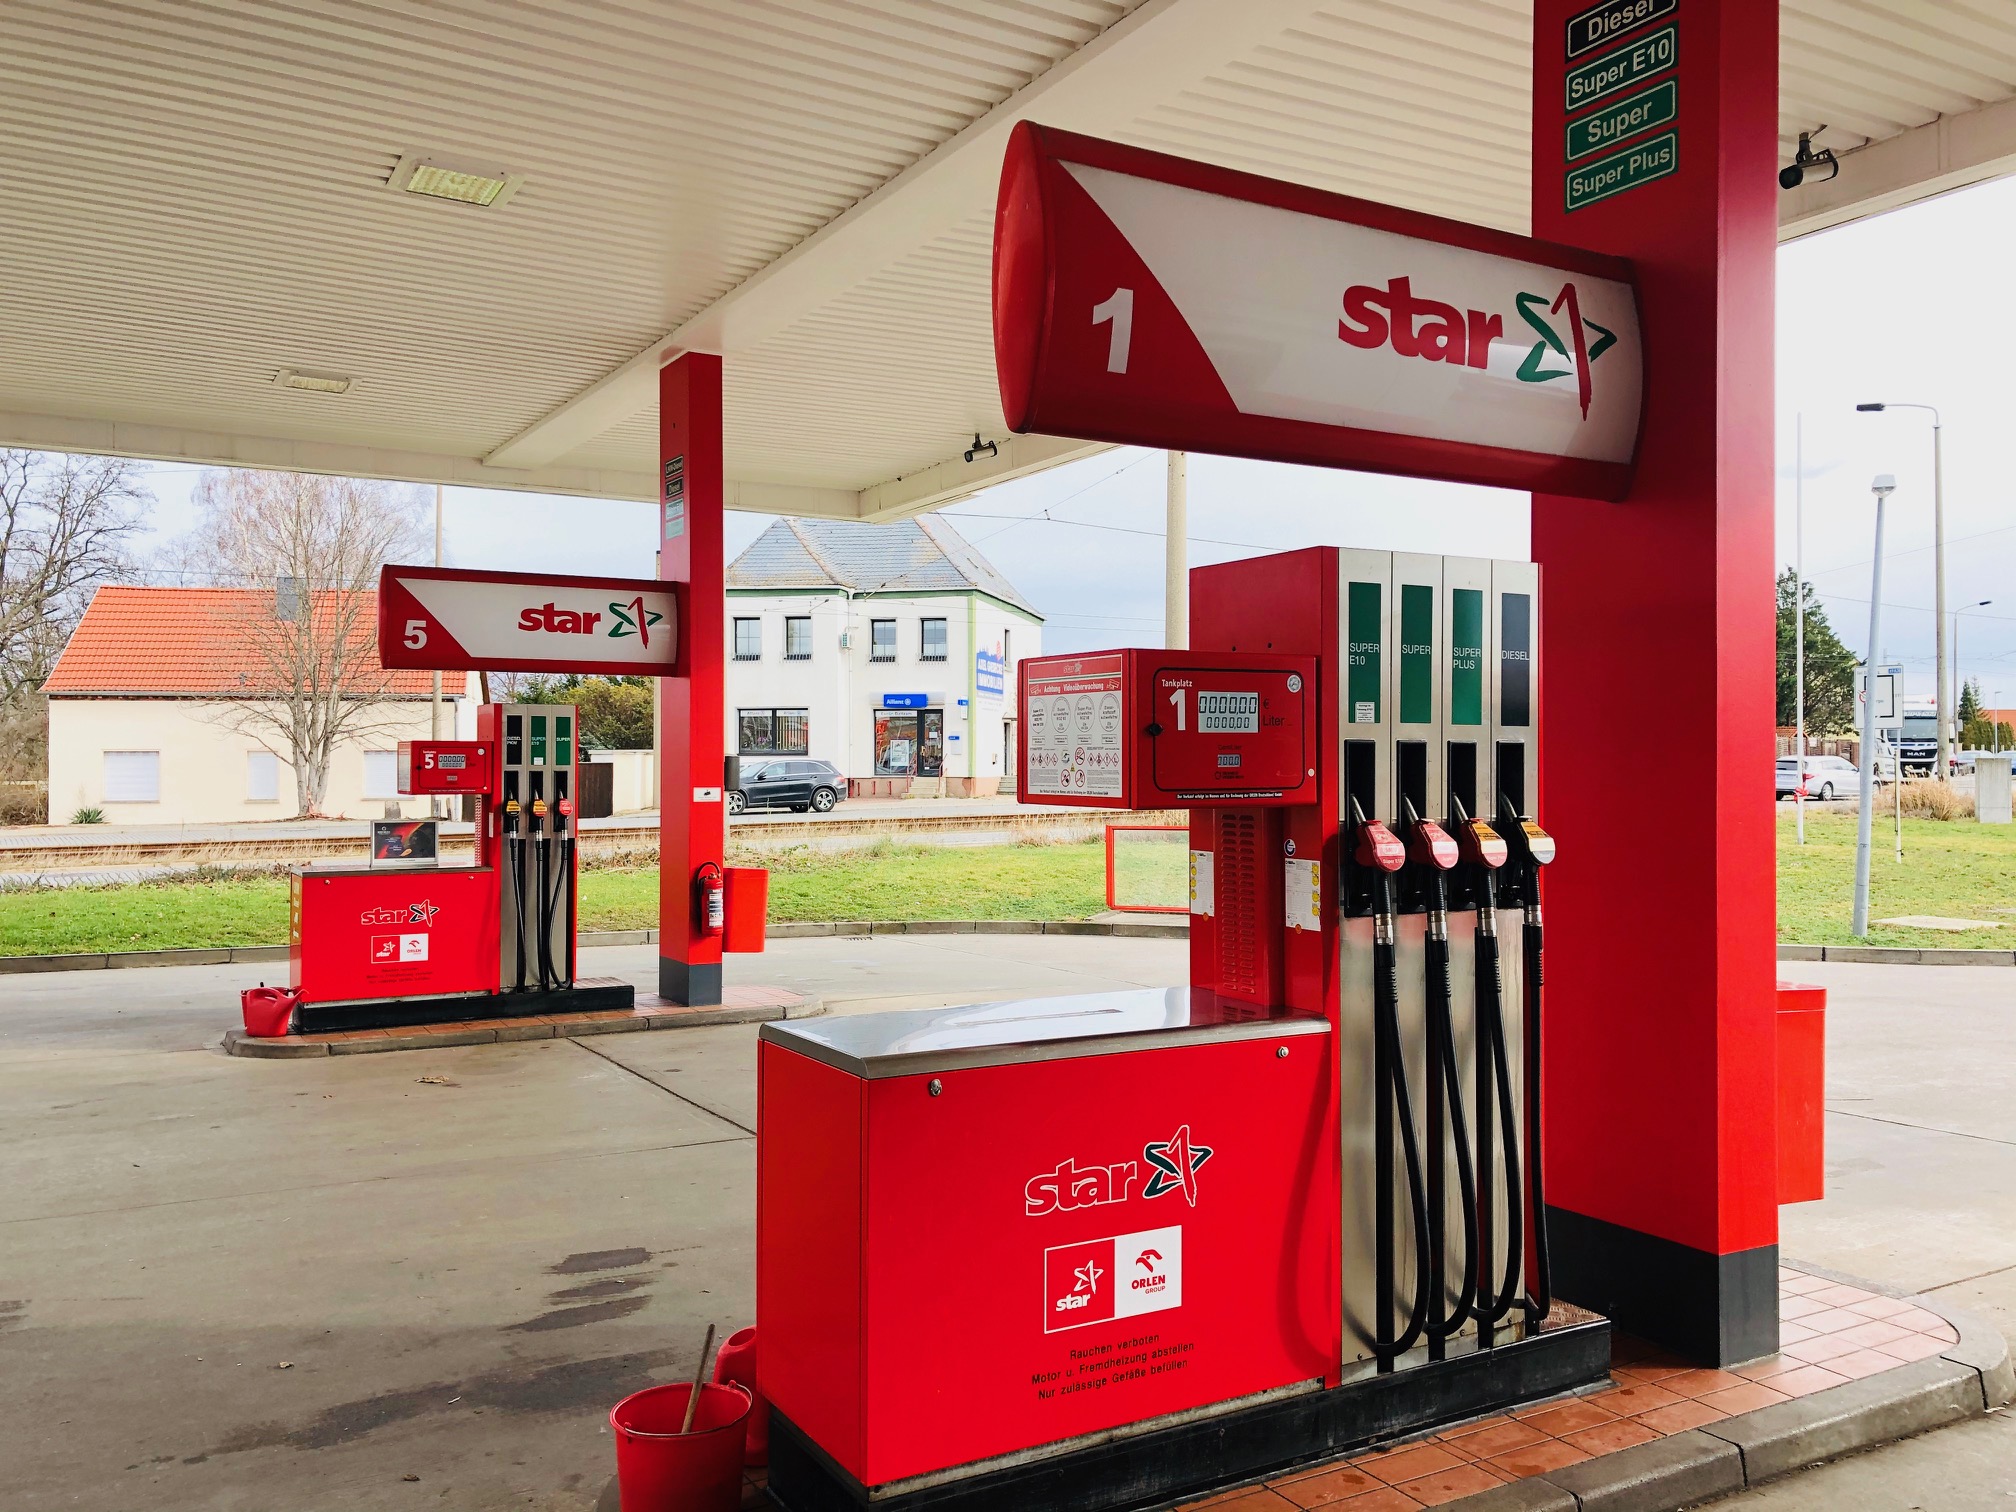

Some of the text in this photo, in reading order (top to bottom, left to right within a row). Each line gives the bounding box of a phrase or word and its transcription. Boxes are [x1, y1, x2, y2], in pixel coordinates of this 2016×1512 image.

[1571, 38, 1670, 98] Super E10
[1588, 101, 1653, 143] Super
[1572, 148, 1670, 197] Super Plus
[1092, 287, 1135, 375] 1
[1337, 275, 1503, 369] star
[518, 602, 602, 635] star
[402, 619, 428, 650] 5
[1349, 642, 1380, 653] SUPER
[1402, 644, 1431, 655] SUPER
[1453, 647, 1482, 658] SUPER
[1501, 650, 1530, 661] DIESEL
[1349, 655, 1366, 666] E10
[1453, 659, 1475, 670] PLUS
[1161, 679, 1193, 688] Tankplatz
[1169, 689, 1186, 731] 1
[1263, 715, 1286, 727] Liter
[424, 753, 434, 770] 5
[361, 906, 408, 926] star
[1025, 1157, 1138, 1217] star
[1131, 1275, 1166, 1290] ORLEN
[1145, 1286, 1166, 1294] GROUP
[1056, 1293, 1091, 1312] star
[1070, 1334, 1160, 1360] Rauchen verboten
[1032, 1371, 1061, 1385] Motor
[1079, 1352, 1147, 1375] Fremdheizung
[1152, 1342, 1194, 1359] abstellen
[1038, 1359, 1188, 1400] Nur zulässige Gefäße befüllen
